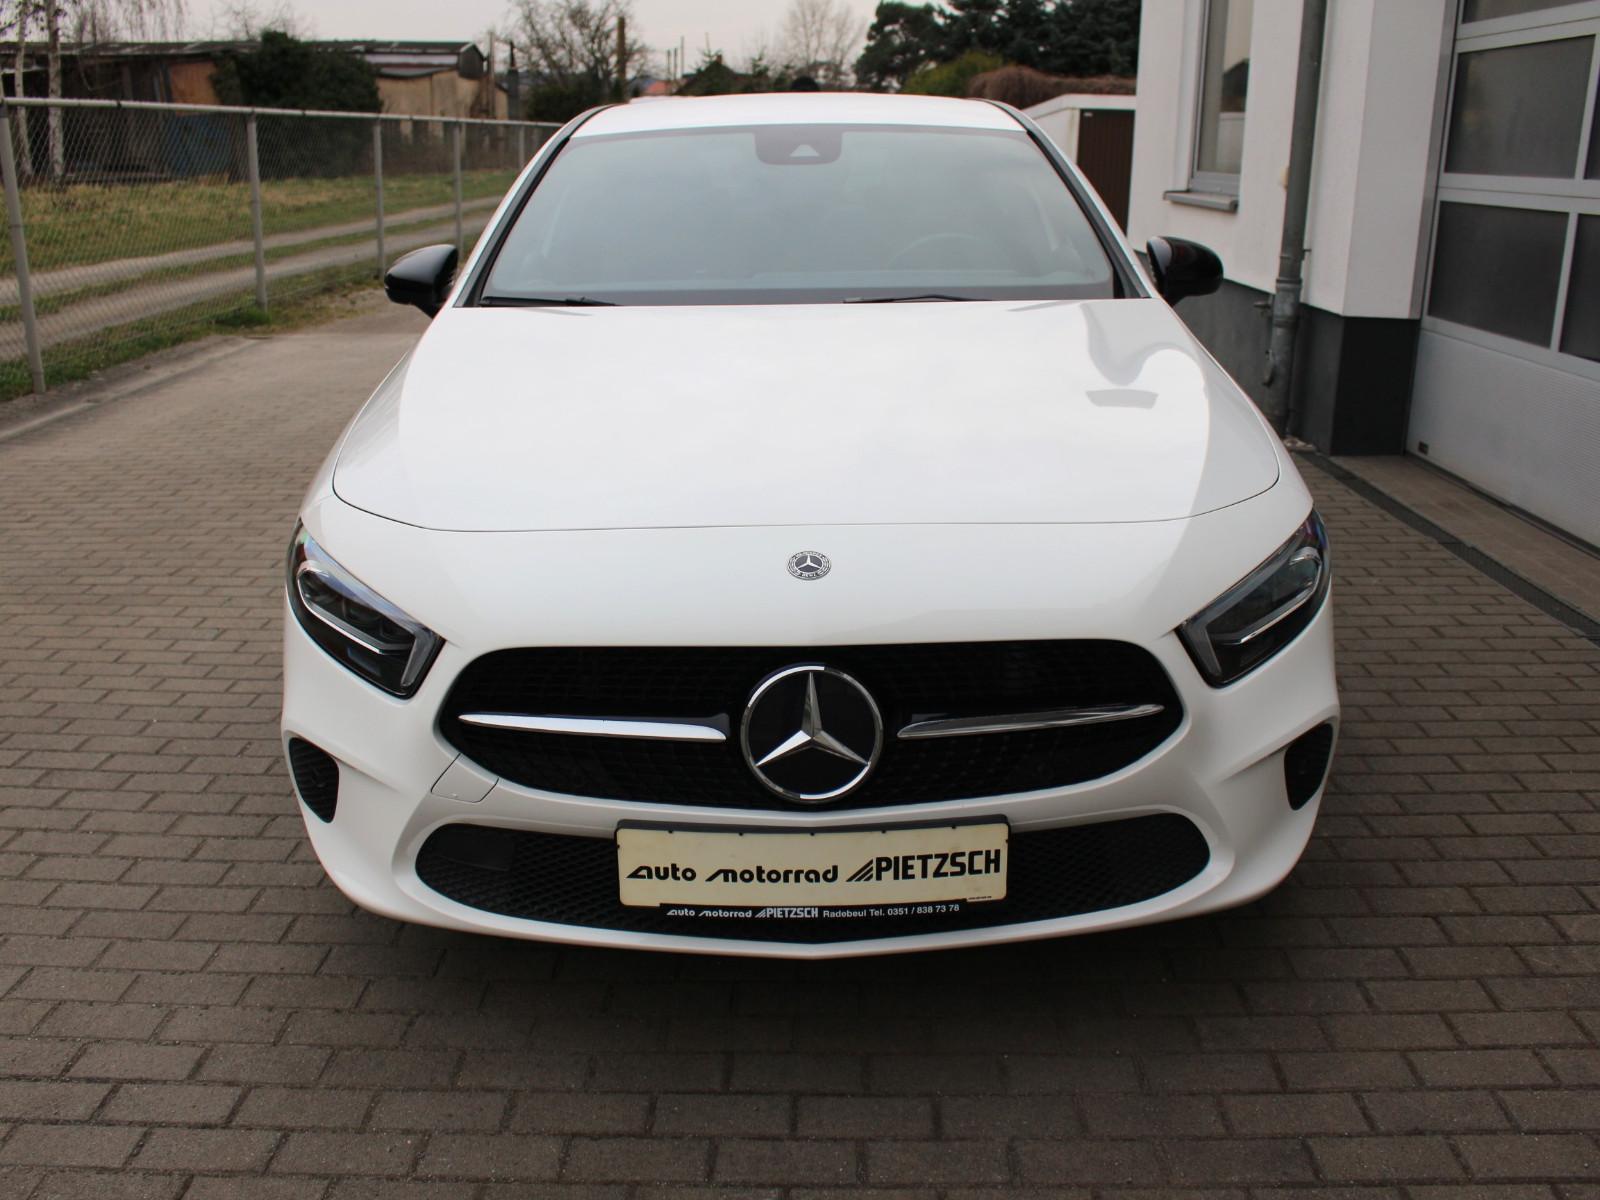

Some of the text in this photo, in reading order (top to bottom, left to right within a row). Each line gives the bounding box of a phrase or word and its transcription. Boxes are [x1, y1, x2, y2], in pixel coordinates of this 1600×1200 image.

[876, 848, 1001, 882] PIETZSCH
[765, 907, 819, 919] PIETZSCH
[822, 909, 867, 919] Radebeul
[869, 909, 885, 917] Tel.
[887, 907, 909, 917] 0351
[916, 905, 934, 915] 838
[935, 905, 948, 914] 73
